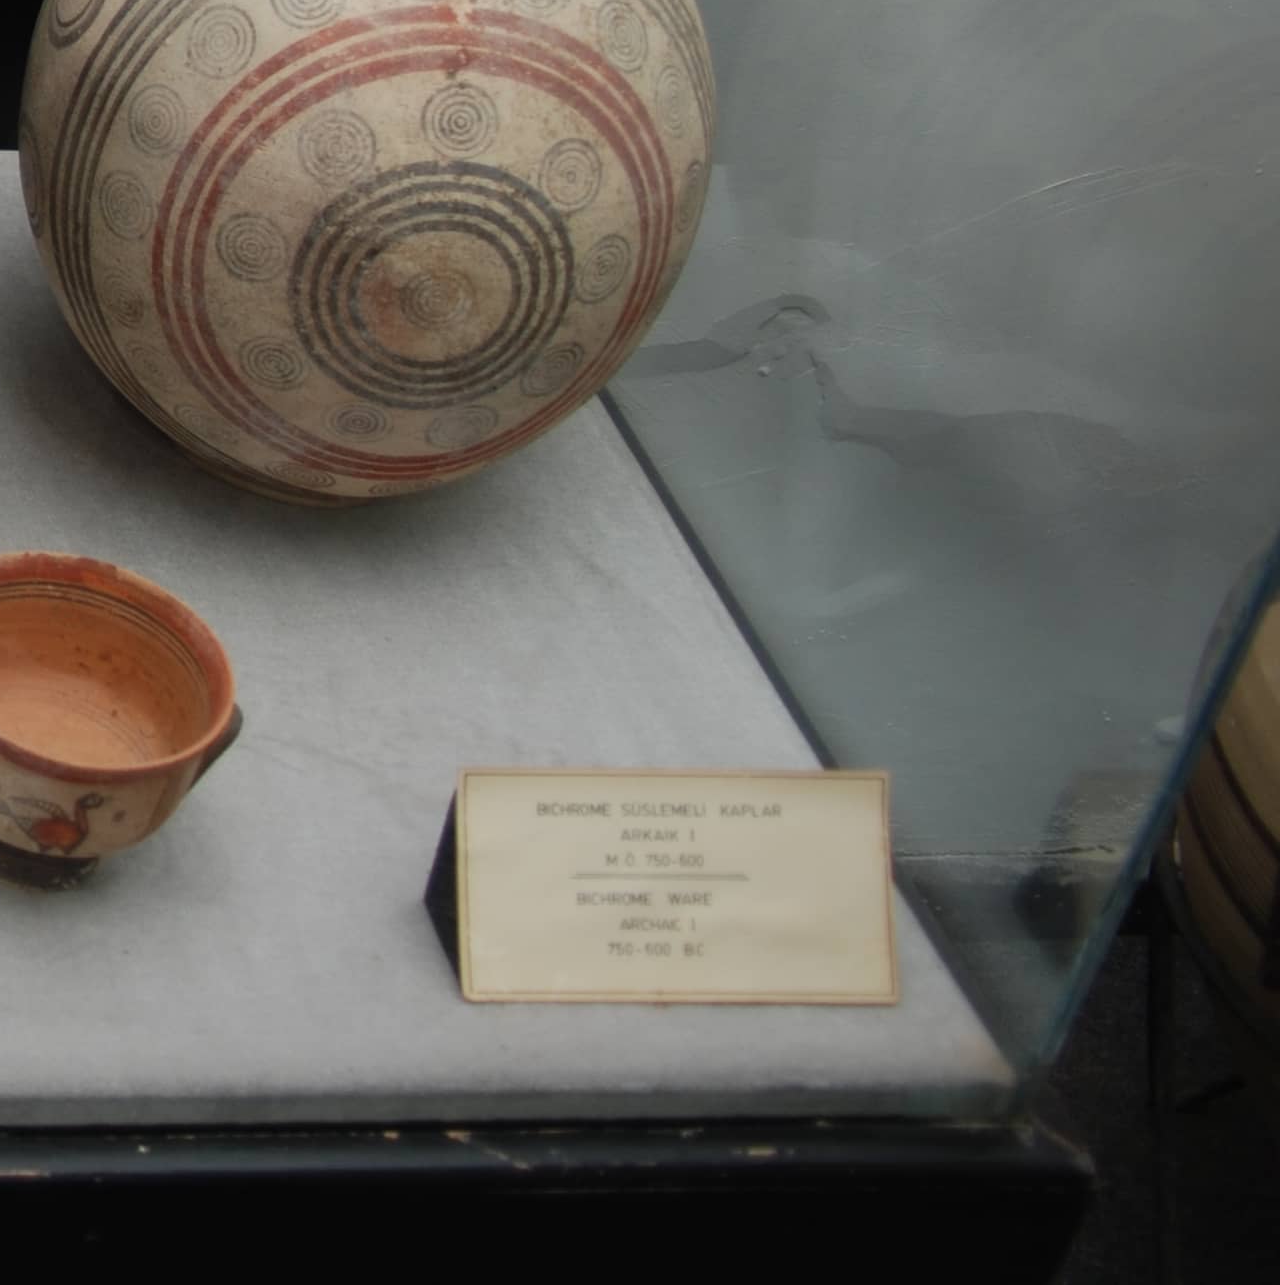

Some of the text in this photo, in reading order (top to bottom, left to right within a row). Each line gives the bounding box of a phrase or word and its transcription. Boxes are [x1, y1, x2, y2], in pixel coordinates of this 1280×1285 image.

[536, 801, 612, 817] BICHROME
[719, 802, 783, 818] KAPLAR
[576, 892, 713, 906] BICHROME WARE
